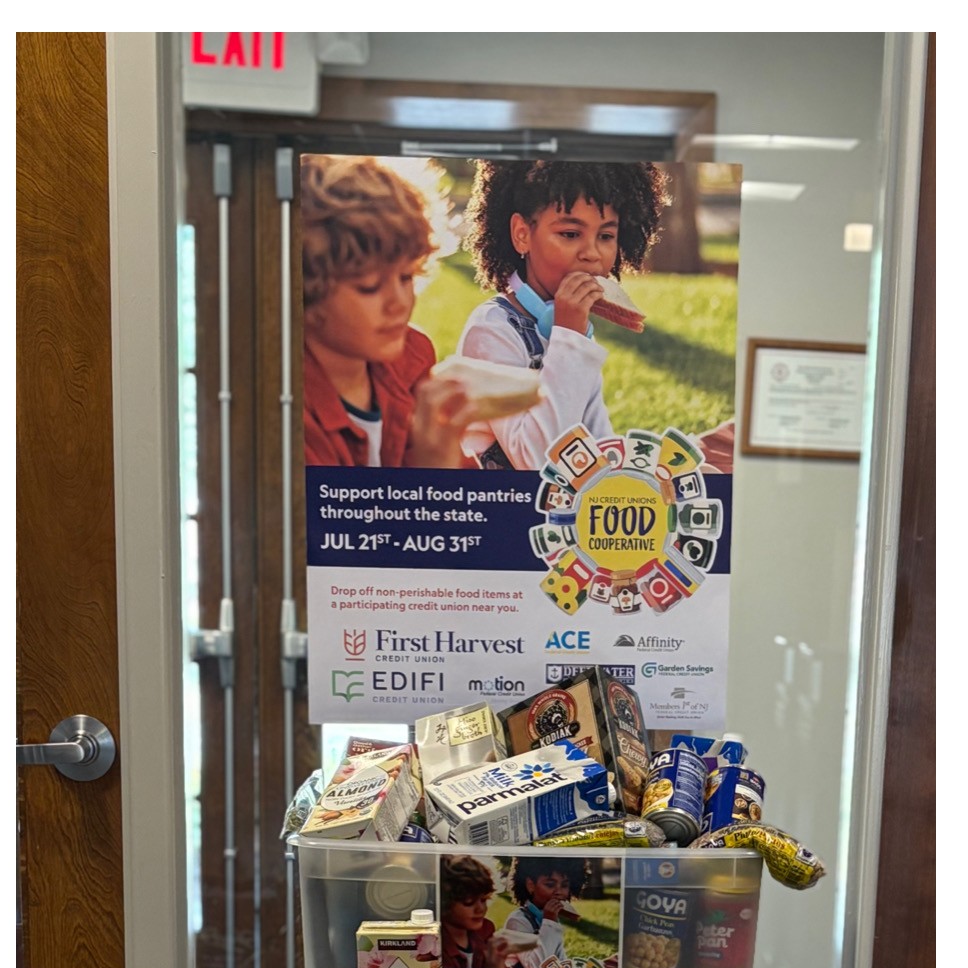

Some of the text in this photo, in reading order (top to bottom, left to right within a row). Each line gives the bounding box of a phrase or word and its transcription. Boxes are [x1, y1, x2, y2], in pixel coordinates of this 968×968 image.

[319, 484, 531, 505] Support local food pantries
[319, 505, 488, 523] throughout the state.
[589, 505, 656, 536] FOOD
[320, 533, 482, 552] JUL 21ST AUG 31ST
[588, 538, 655, 551] COOPERATIVE
[331, 586, 523, 599] Drop off non-perishable food items at
[331, 600, 519, 614] a participating credit union near you.
[375, 629, 525, 654] First Harvest
[545, 631, 590, 649] ACE
[637, 636, 682, 650] Affinity
[414, 655, 445, 663] UNION
[686, 665, 714, 673] Savings
[372, 670, 444, 691] EDIFI
[488, 767, 515, 788] Milk
[326, 778, 387, 798] ALMOND
[456, 771, 568, 815] parmalat
[636, 890, 687, 915] GOYA
